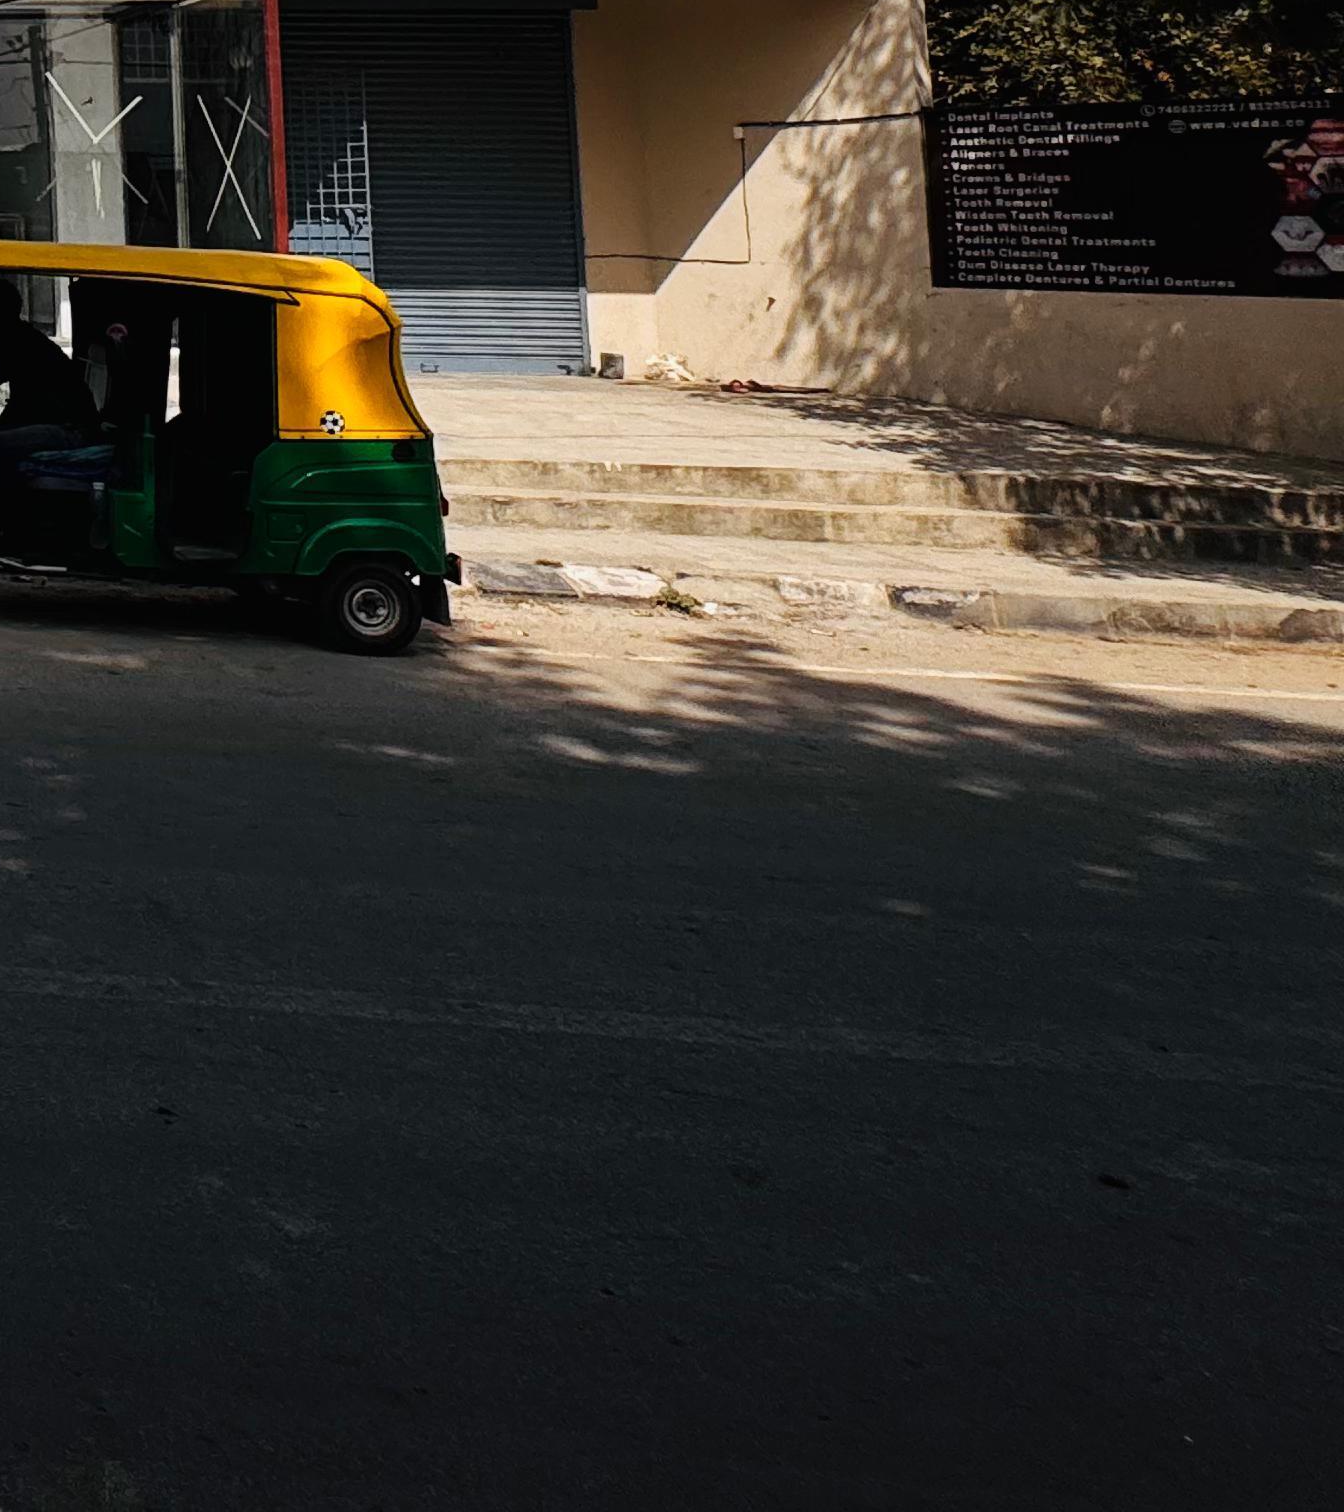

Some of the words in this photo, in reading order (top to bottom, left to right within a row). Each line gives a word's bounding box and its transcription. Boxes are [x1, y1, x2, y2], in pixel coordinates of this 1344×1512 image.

[1023, 122, 1062, 133] Canal
[1066, 120, 1150, 131] Treatments
[1066, 133, 1121, 145] Fillings
[951, 149, 1006, 160] Aligners
[1023, 148, 1070, 158] Braces
[1018, 172, 1072, 184] Bridges
[993, 186, 1060, 197] Surgeries
[996, 198, 1053, 207] Removal
[955, 211, 1007, 220] Wisdom
[1054, 211, 1115, 221] Removal
[1072, 236, 1157, 247] Treatments
[1091, 262, 1151, 275] Therapy
[1108, 276, 1160, 287] Partial
[1163, 277, 1236, 288] Dentures
